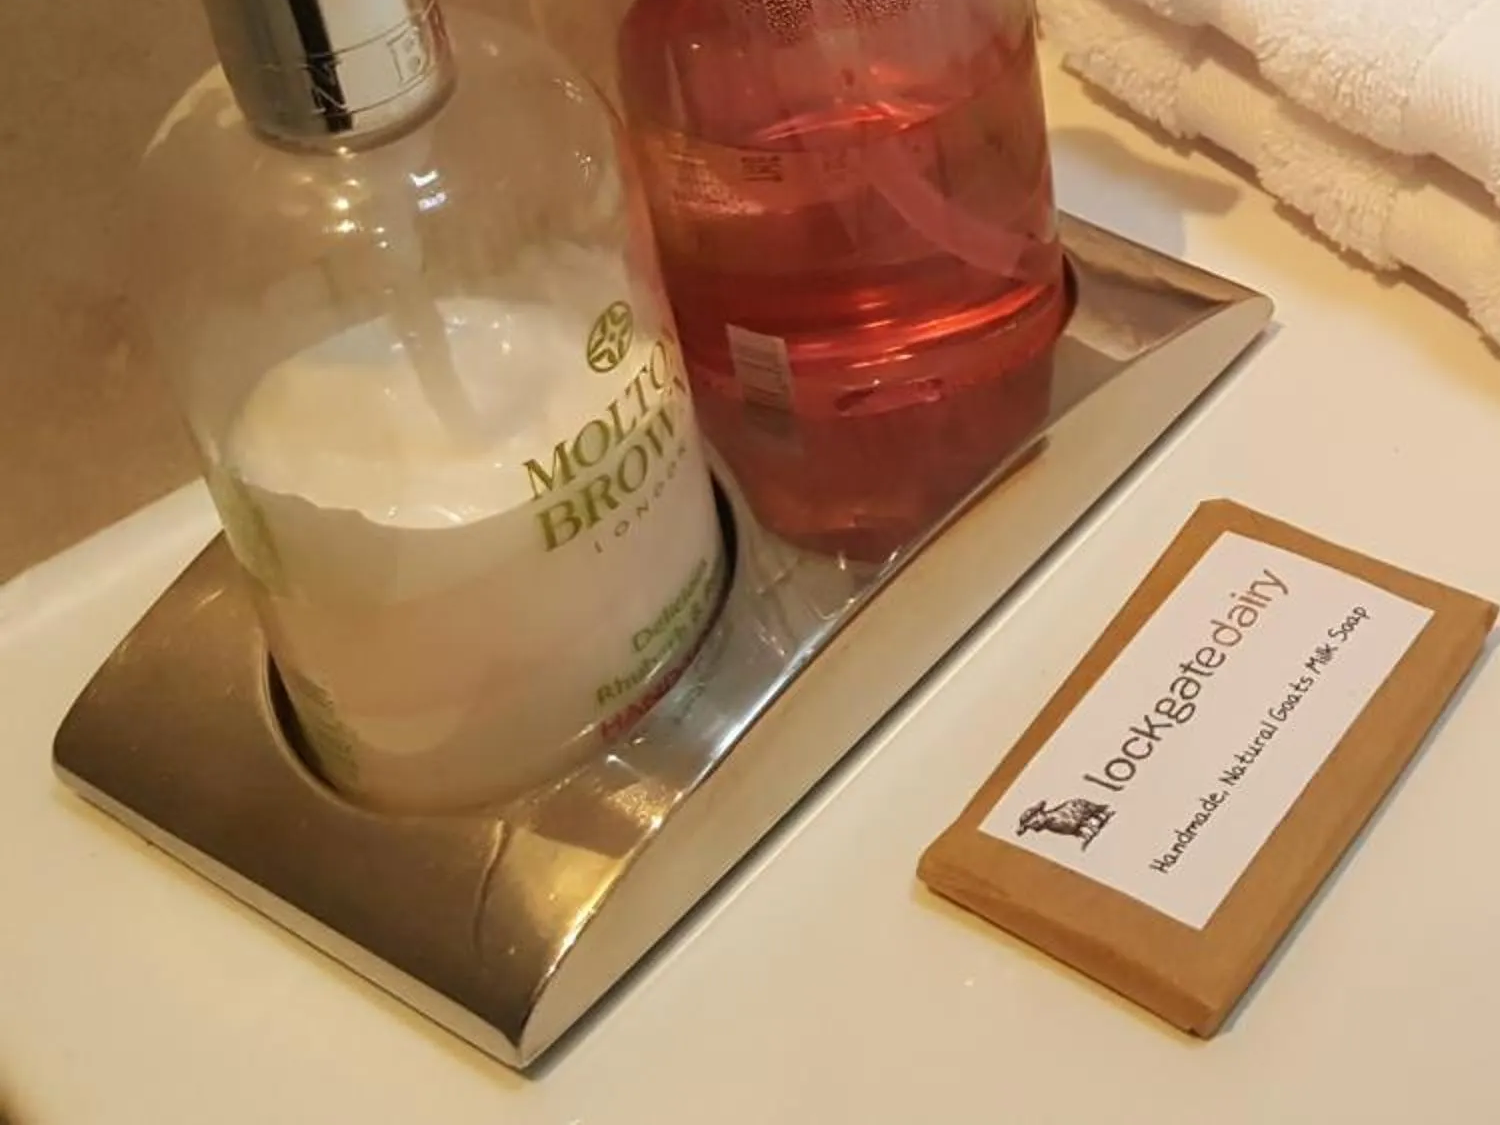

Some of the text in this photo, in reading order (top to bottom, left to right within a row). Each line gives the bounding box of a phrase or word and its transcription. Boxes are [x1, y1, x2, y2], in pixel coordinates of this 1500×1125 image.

[536, 405, 678, 552] BROW
[1150, 606, 1371, 873] Handmade, Natural Goats Milk Soap
